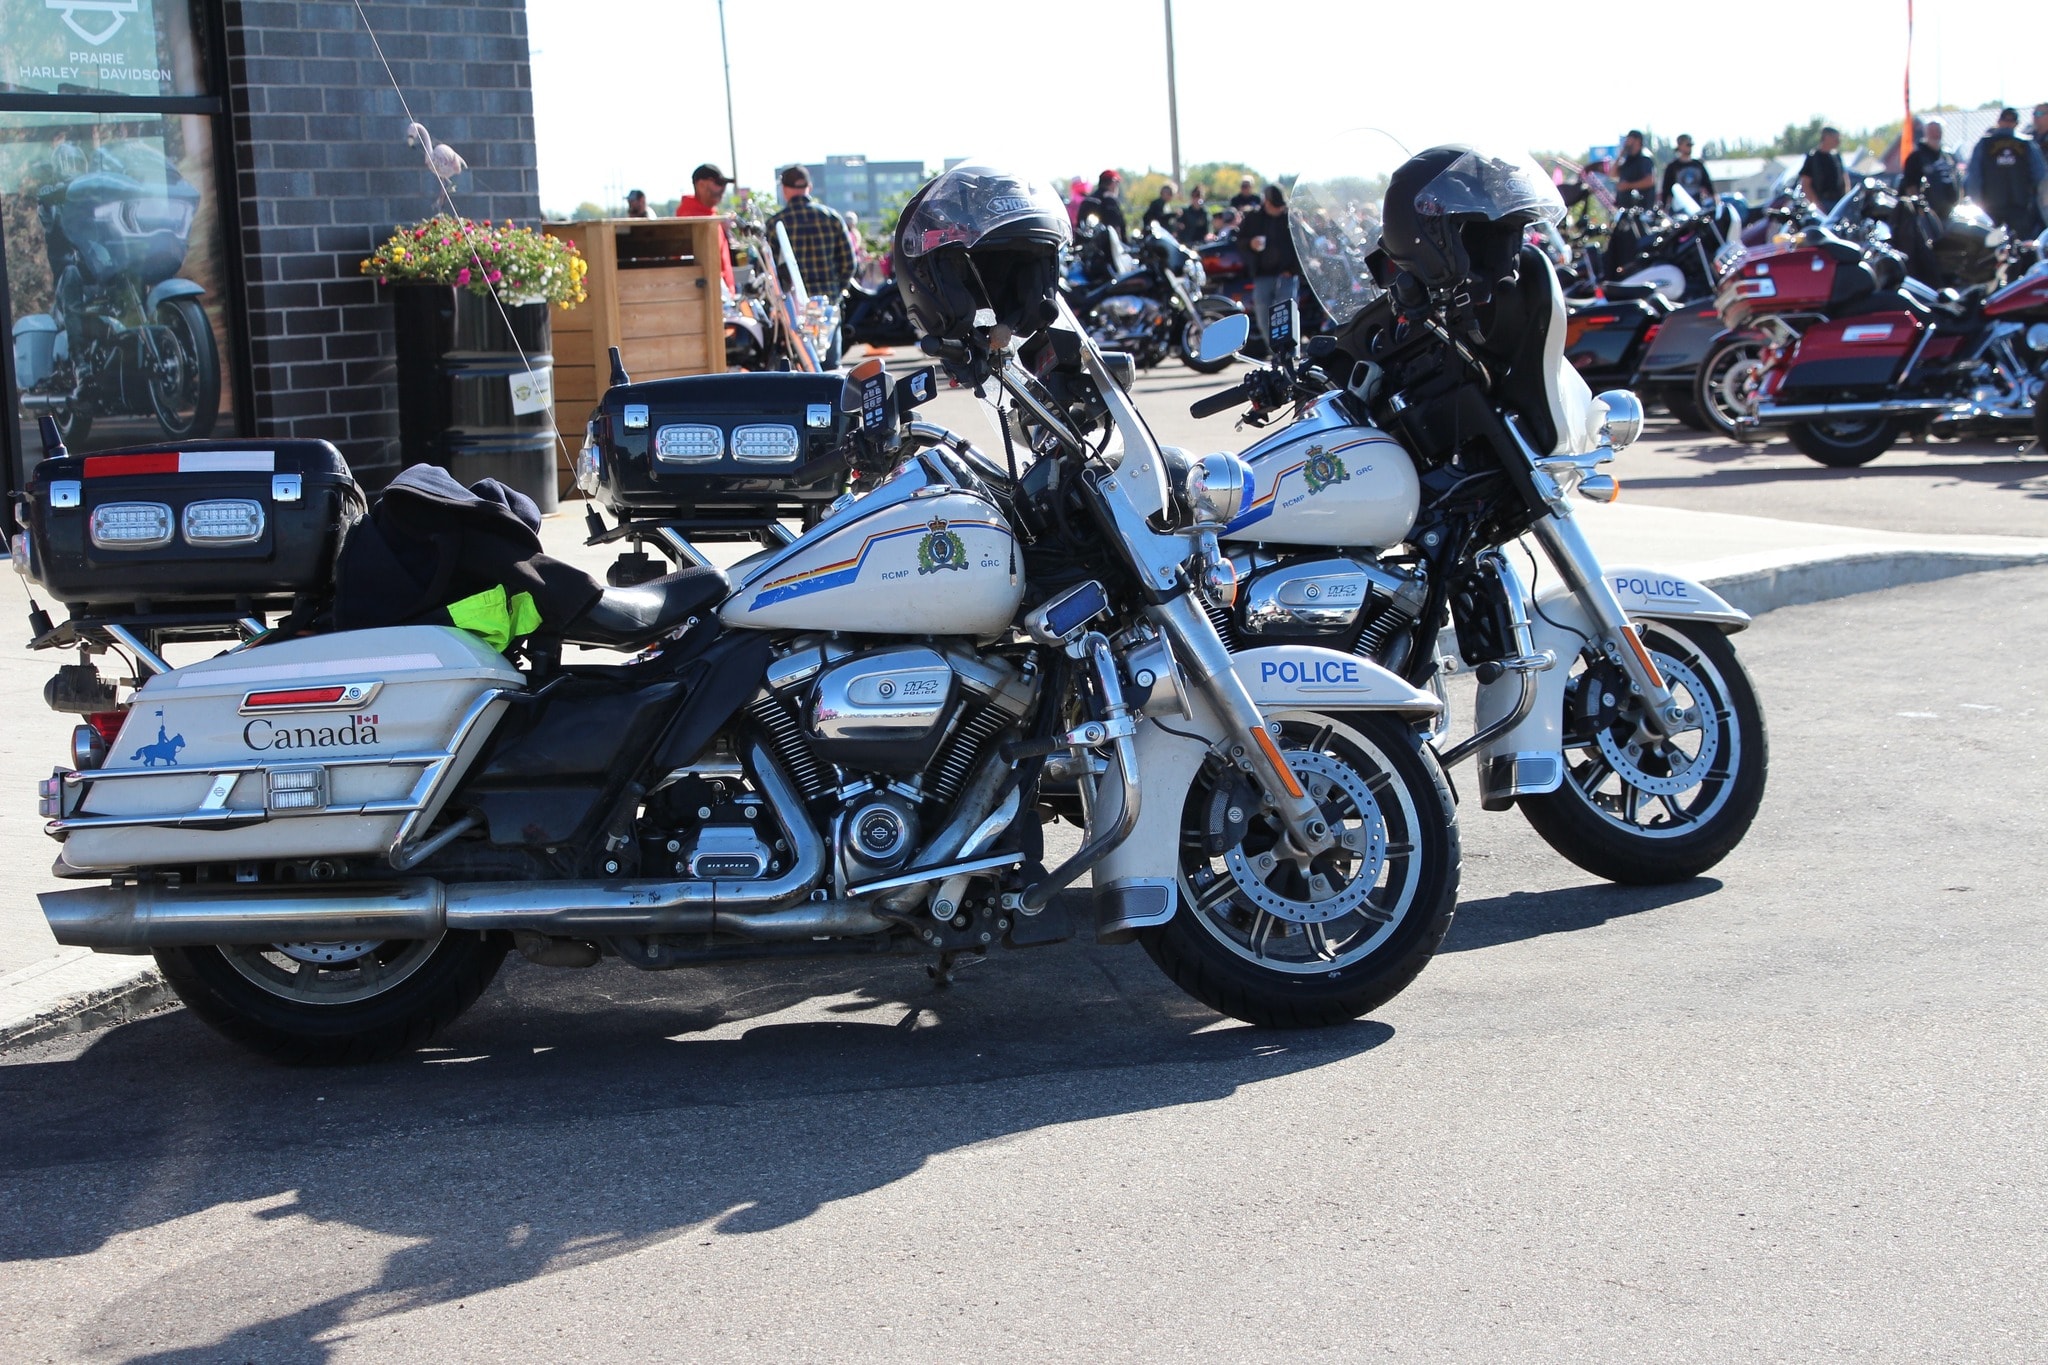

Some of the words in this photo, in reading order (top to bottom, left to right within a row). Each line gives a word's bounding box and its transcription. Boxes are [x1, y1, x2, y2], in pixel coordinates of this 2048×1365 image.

[69, 52, 125, 65] PRAIRIE
[19, 66, 79, 79] HARLEY
[100, 67, 171, 81] DAVIDSON
[1355, 464, 1374, 476] GRC
[1282, 494, 1305, 509] RCMP
[980, 559, 1000, 568] GRC
[881, 569, 909, 580] RCMP
[1615, 578, 1688, 597] POLICE
[1260, 661, 1360, 684] POLICE
[904, 679, 939, 692] 114
[243, 714, 380, 751] Canada
